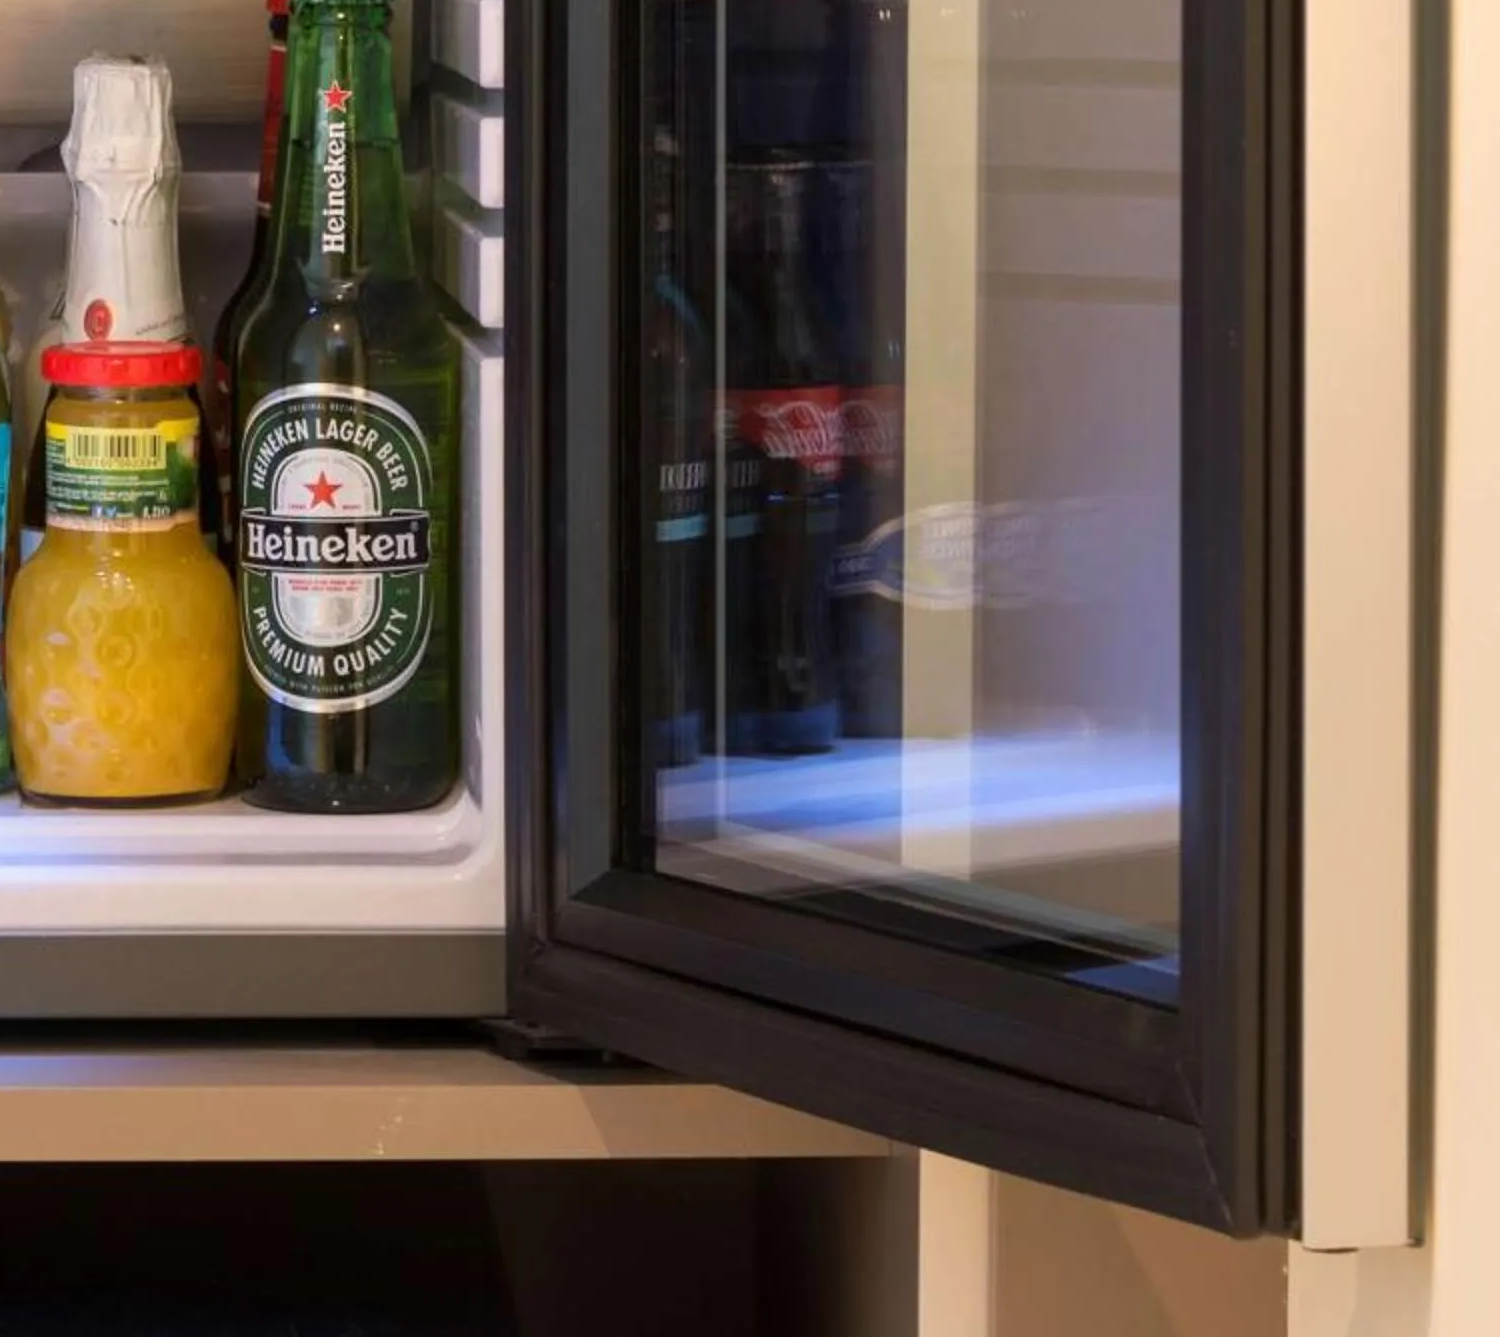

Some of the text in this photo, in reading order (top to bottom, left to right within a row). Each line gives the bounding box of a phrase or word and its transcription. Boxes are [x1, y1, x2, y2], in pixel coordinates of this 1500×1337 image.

[322, 121, 346, 254] Heineken
[252, 416, 409, 491] HEINEKEN LAGER BEER
[247, 522, 417, 564] Heineken
[253, 606, 408, 678] PREMIUM QUALITY
